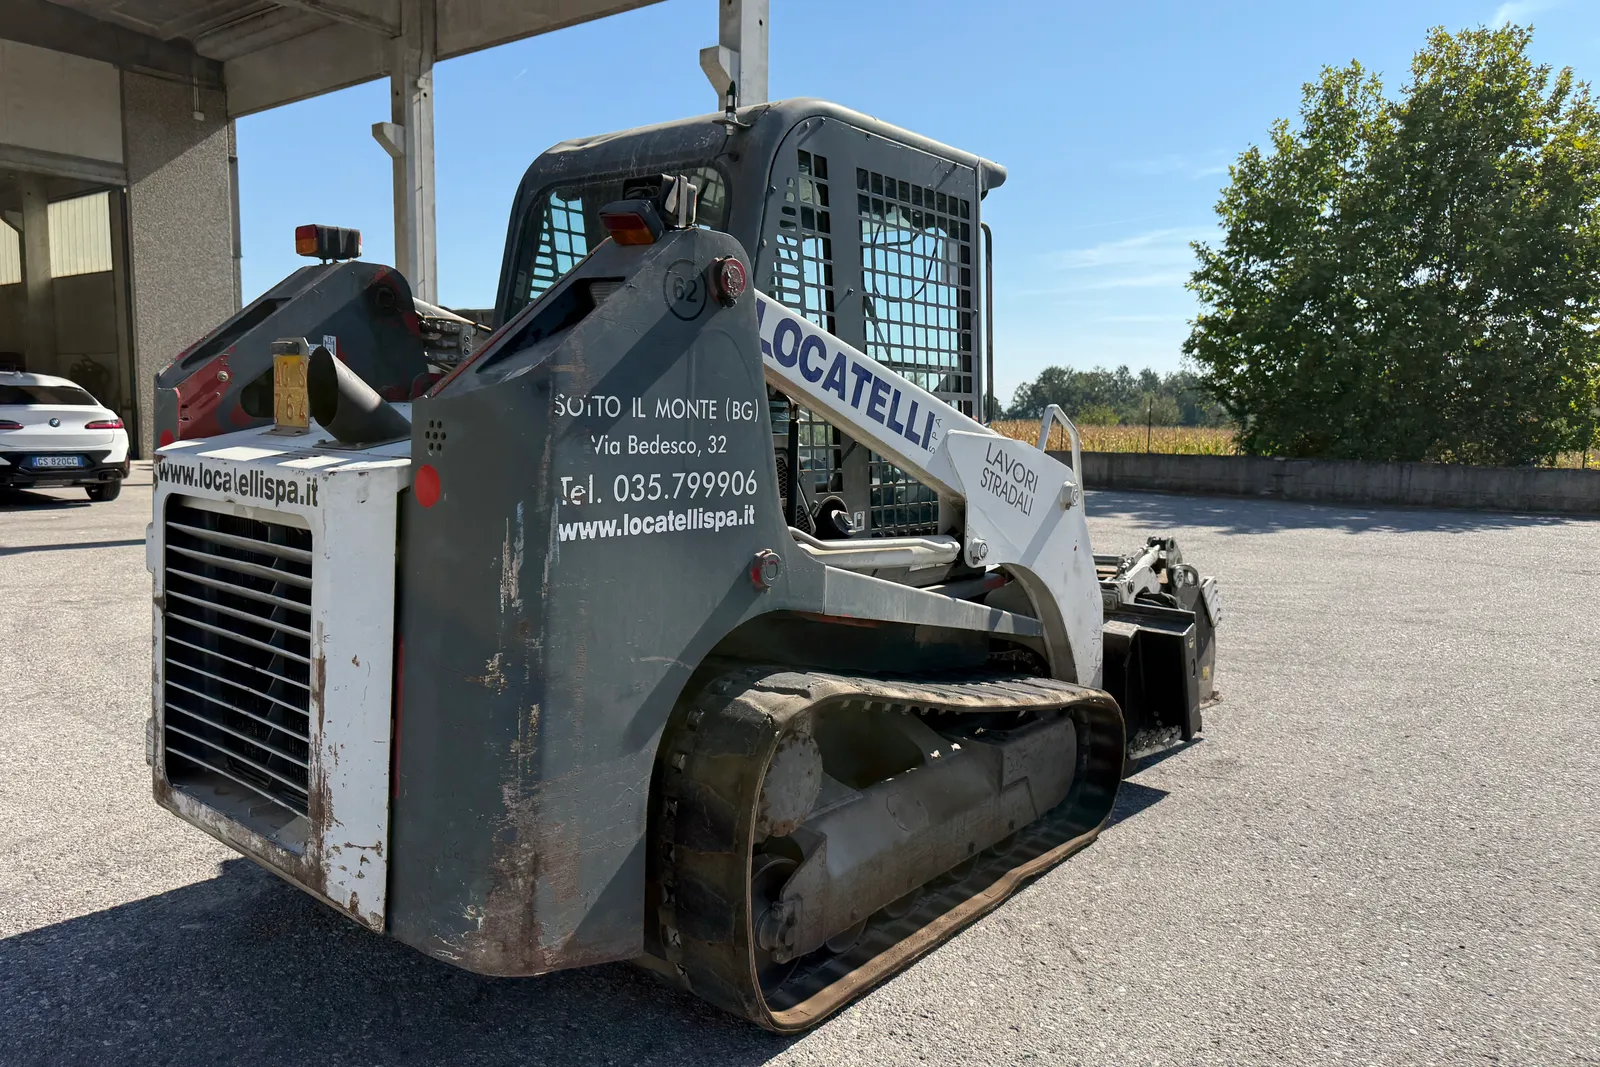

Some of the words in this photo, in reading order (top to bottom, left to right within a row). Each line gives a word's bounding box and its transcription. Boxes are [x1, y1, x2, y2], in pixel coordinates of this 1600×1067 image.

[672, 276, 698, 303] 62
[756, 298, 936, 451] LOCATELLI
[632, 397, 646, 418] IL
[655, 398, 718, 420] MONTE
[725, 397, 759, 423] (BG)
[590, 434, 621, 455] Via
[628, 434, 702, 458] Bedesco,
[707, 435, 727, 454] 32
[158, 462, 319, 508] www.locatellispa.it
[985, 441, 1039, 494] LAVORI
[559, 474, 602, 506] Tel.
[613, 469, 758, 503] 035.799906
[980, 467, 1034, 517] STRADALI
[558, 504, 755, 542] www.locatellispa.it
